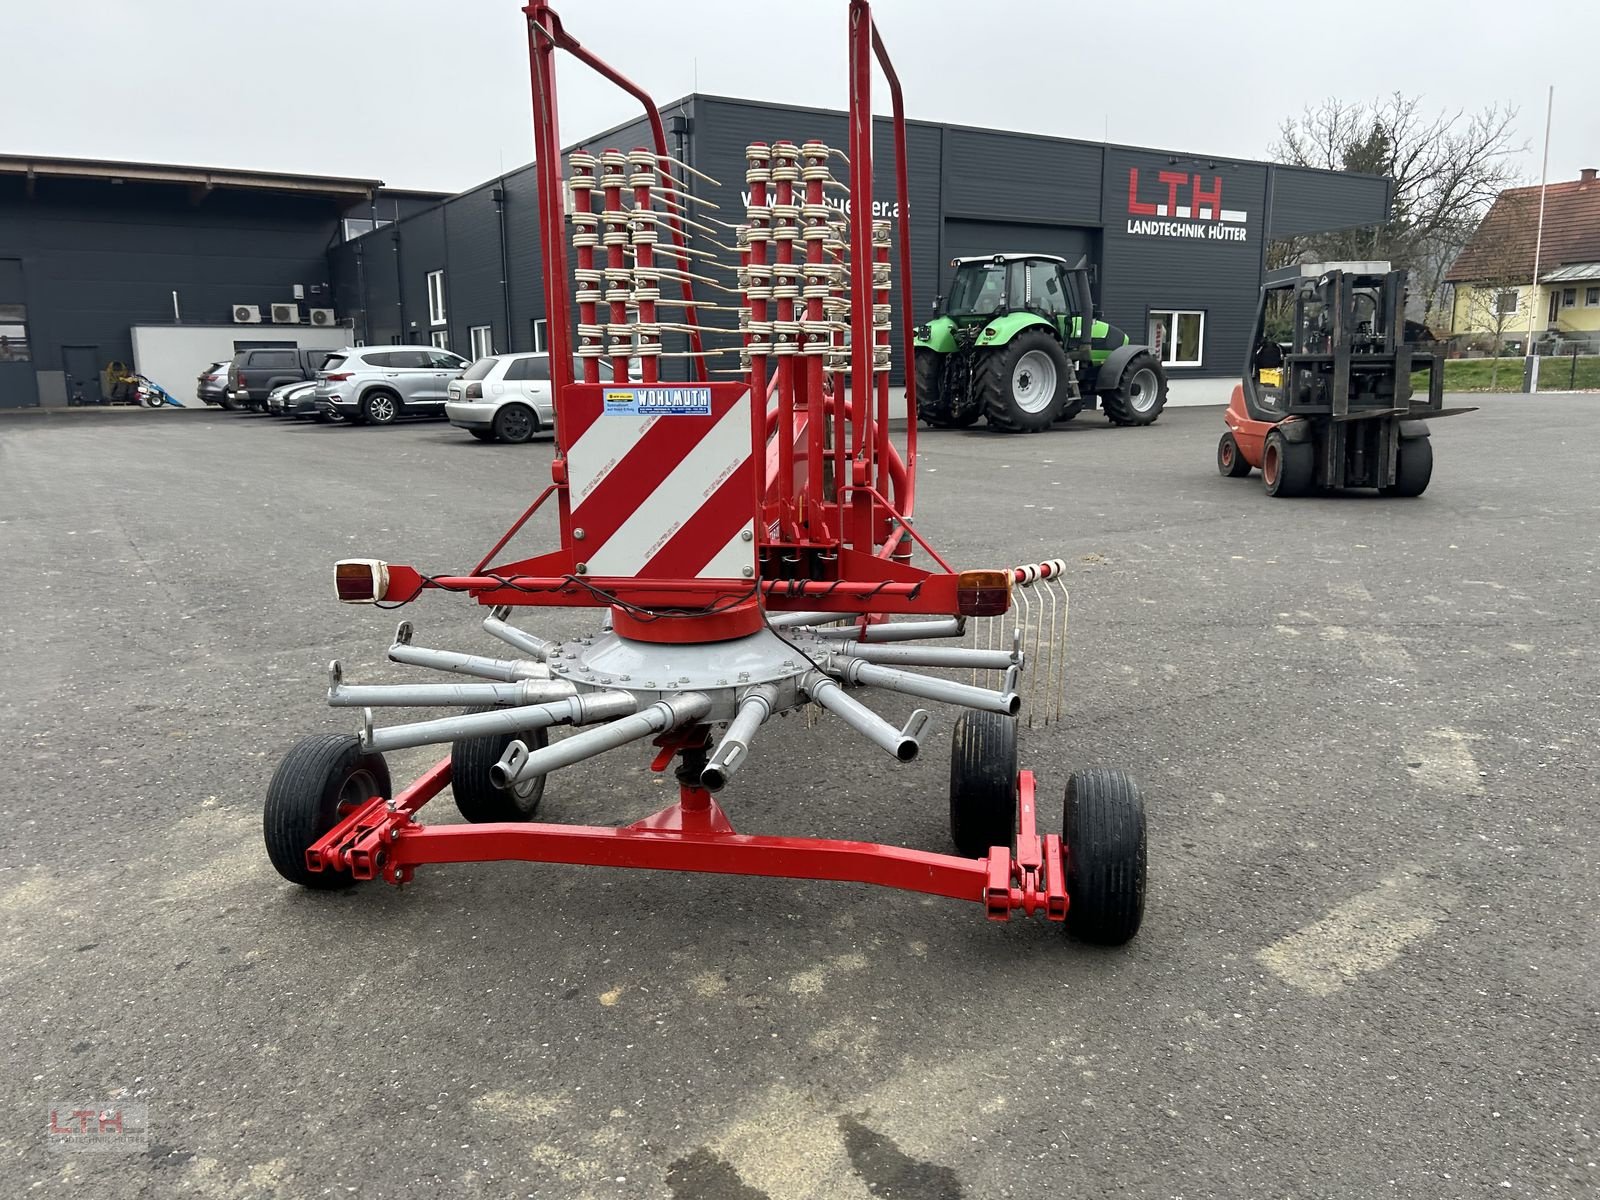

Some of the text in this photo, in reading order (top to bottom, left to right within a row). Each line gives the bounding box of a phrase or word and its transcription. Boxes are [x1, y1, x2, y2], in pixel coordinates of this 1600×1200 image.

[1128, 166, 1222, 220] LTH
[1127, 219, 1247, 241] LANDTECHNIK HÜTTER
[637, 389, 708, 407] WOHLMUTH
